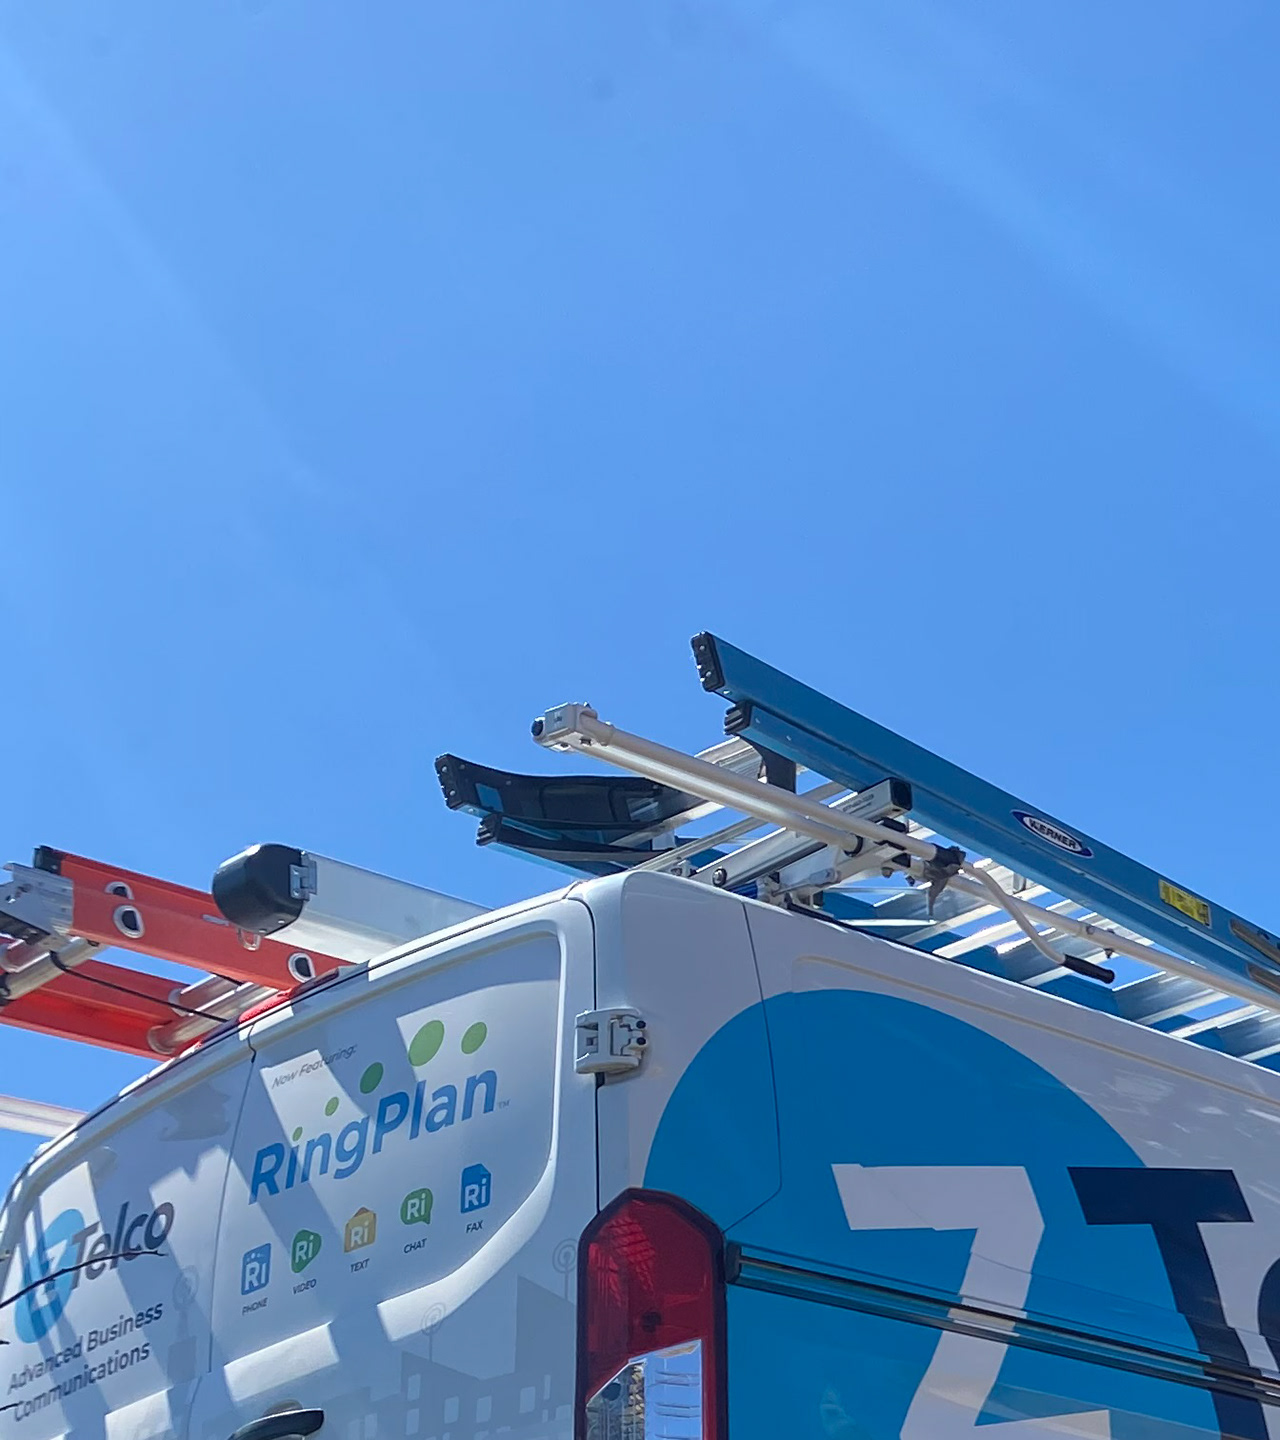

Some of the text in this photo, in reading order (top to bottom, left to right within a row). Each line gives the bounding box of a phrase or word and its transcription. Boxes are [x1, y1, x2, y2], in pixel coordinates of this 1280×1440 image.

[1028, 818, 1078, 849] WERNER
[271, 1071, 298, 1090] Now
[248, 1069, 498, 1205] RingPlan
[465, 1219, 485, 1234] FAX
[403, 1237, 428, 1254] CHAT
[350, 1258, 370, 1273] TEXT
[292, 1278, 317, 1295] VIDEO
[241, 1297, 268, 1316] PHONE
[7, 1302, 164, 1395] Advanced Business
[14, 1341, 152, 1423] Communications
